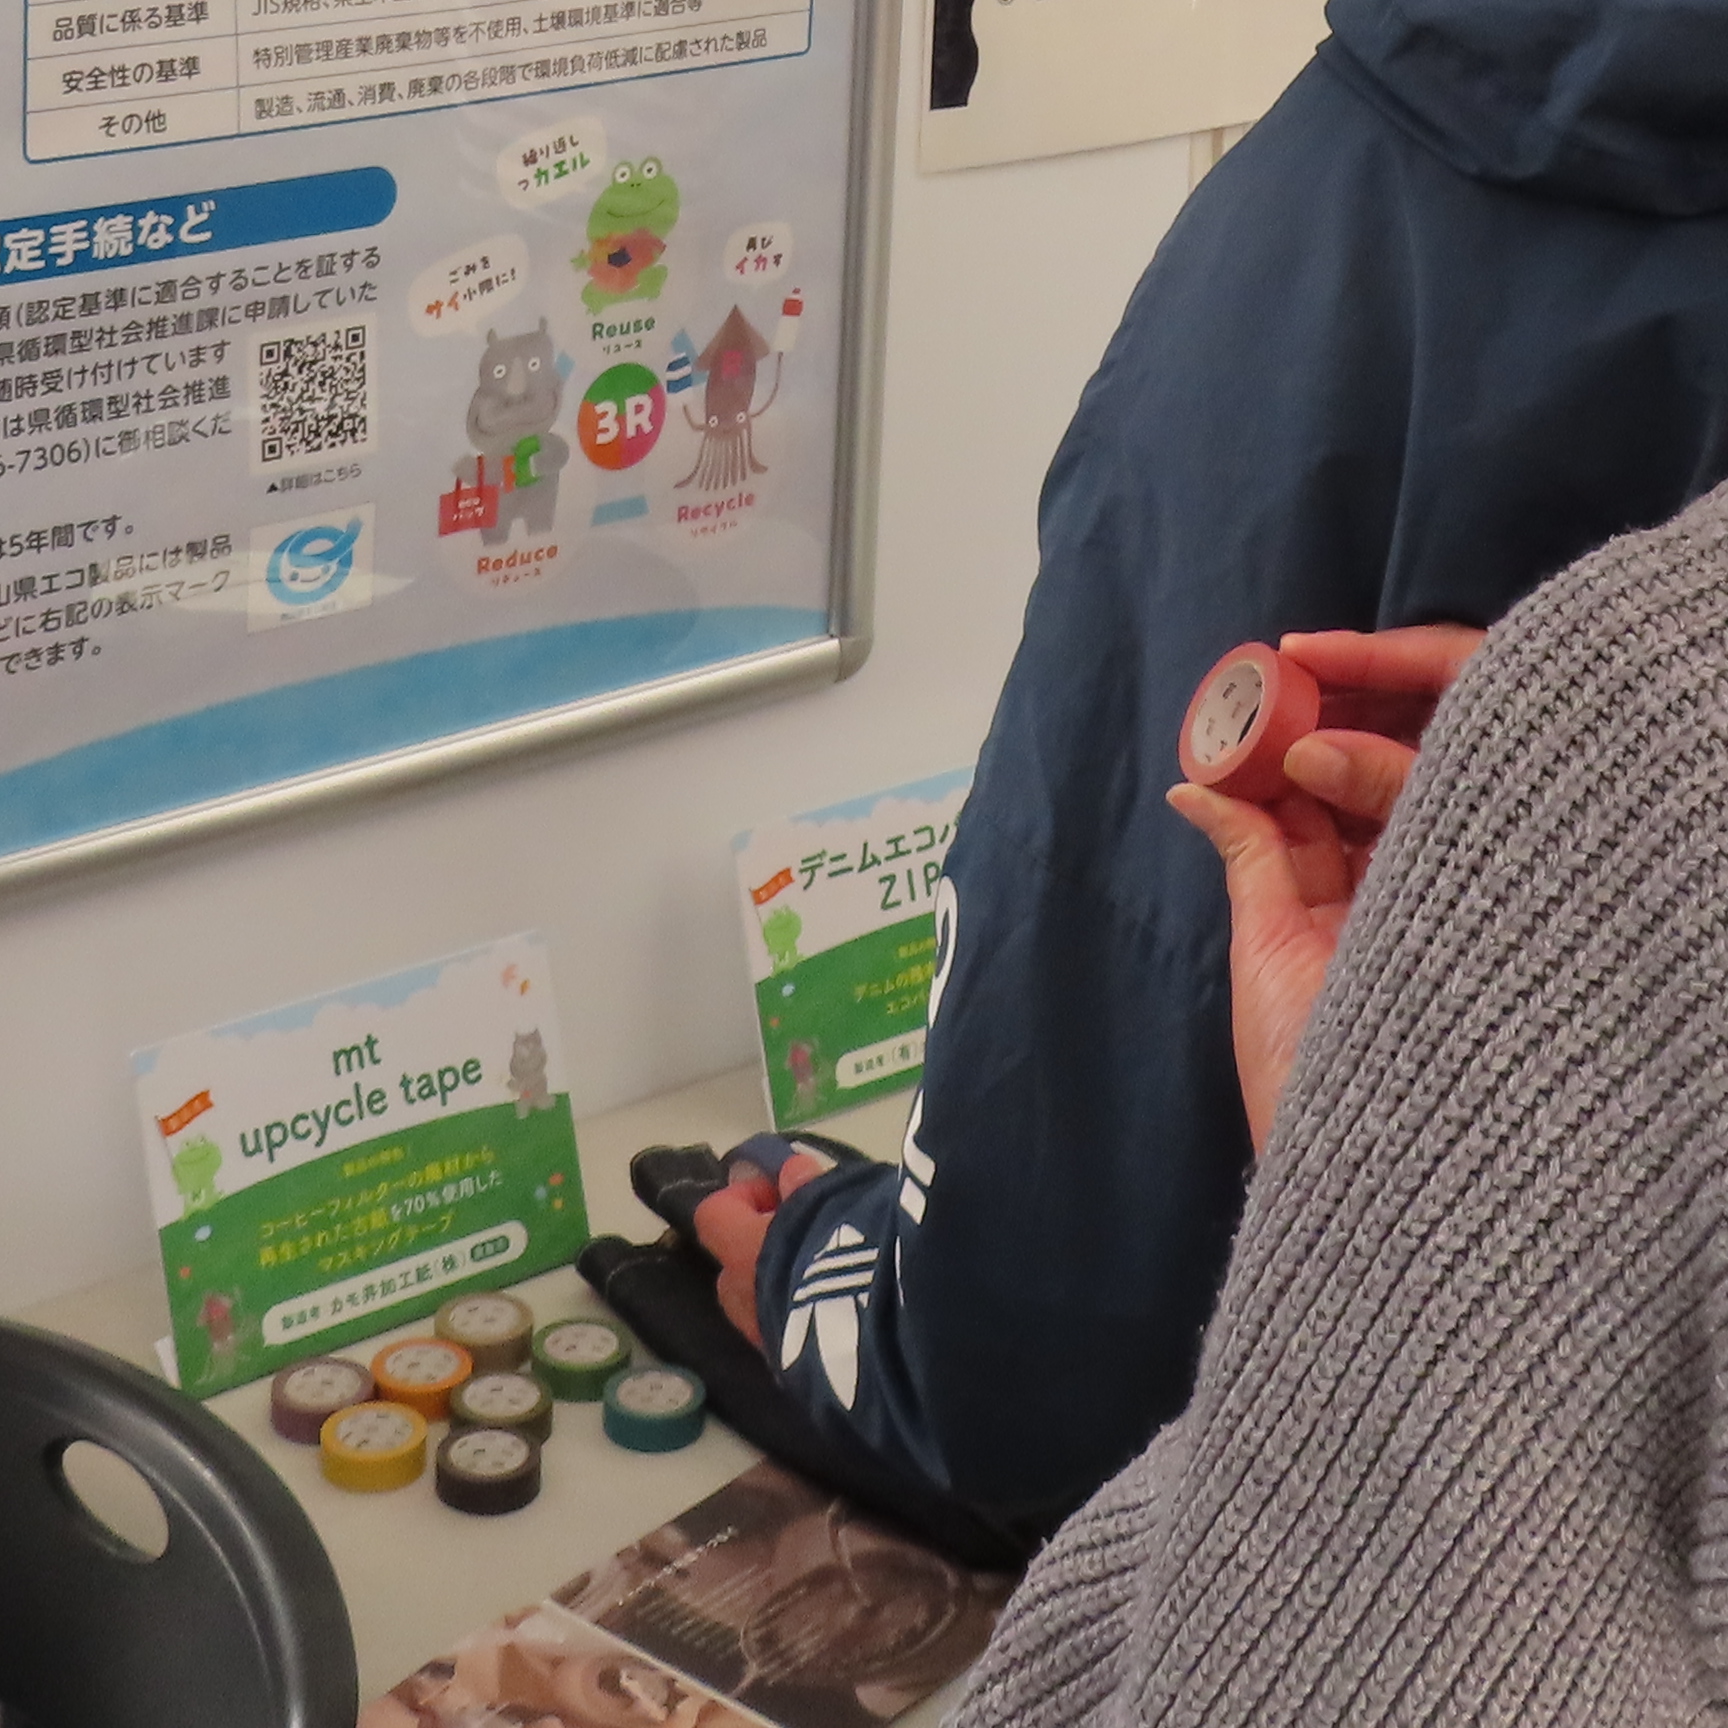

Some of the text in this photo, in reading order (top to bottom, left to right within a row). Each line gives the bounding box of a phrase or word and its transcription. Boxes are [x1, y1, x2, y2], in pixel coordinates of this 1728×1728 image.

[52, 0, 210, 42] 品質に係る基準
[62, 55, 202, 96] 安全性の基準
[99, 108, 168, 138] その他
[591, 316, 657, 342] Reuse
[593, 393, 654, 446] 3R
[676, 491, 756, 524] Recycle
[476, 544, 559, 575] Reduce
[331, 1032, 382, 1079] mt
[238, 1081, 390, 1163] upcycle
[398, 1057, 484, 1106] tape
